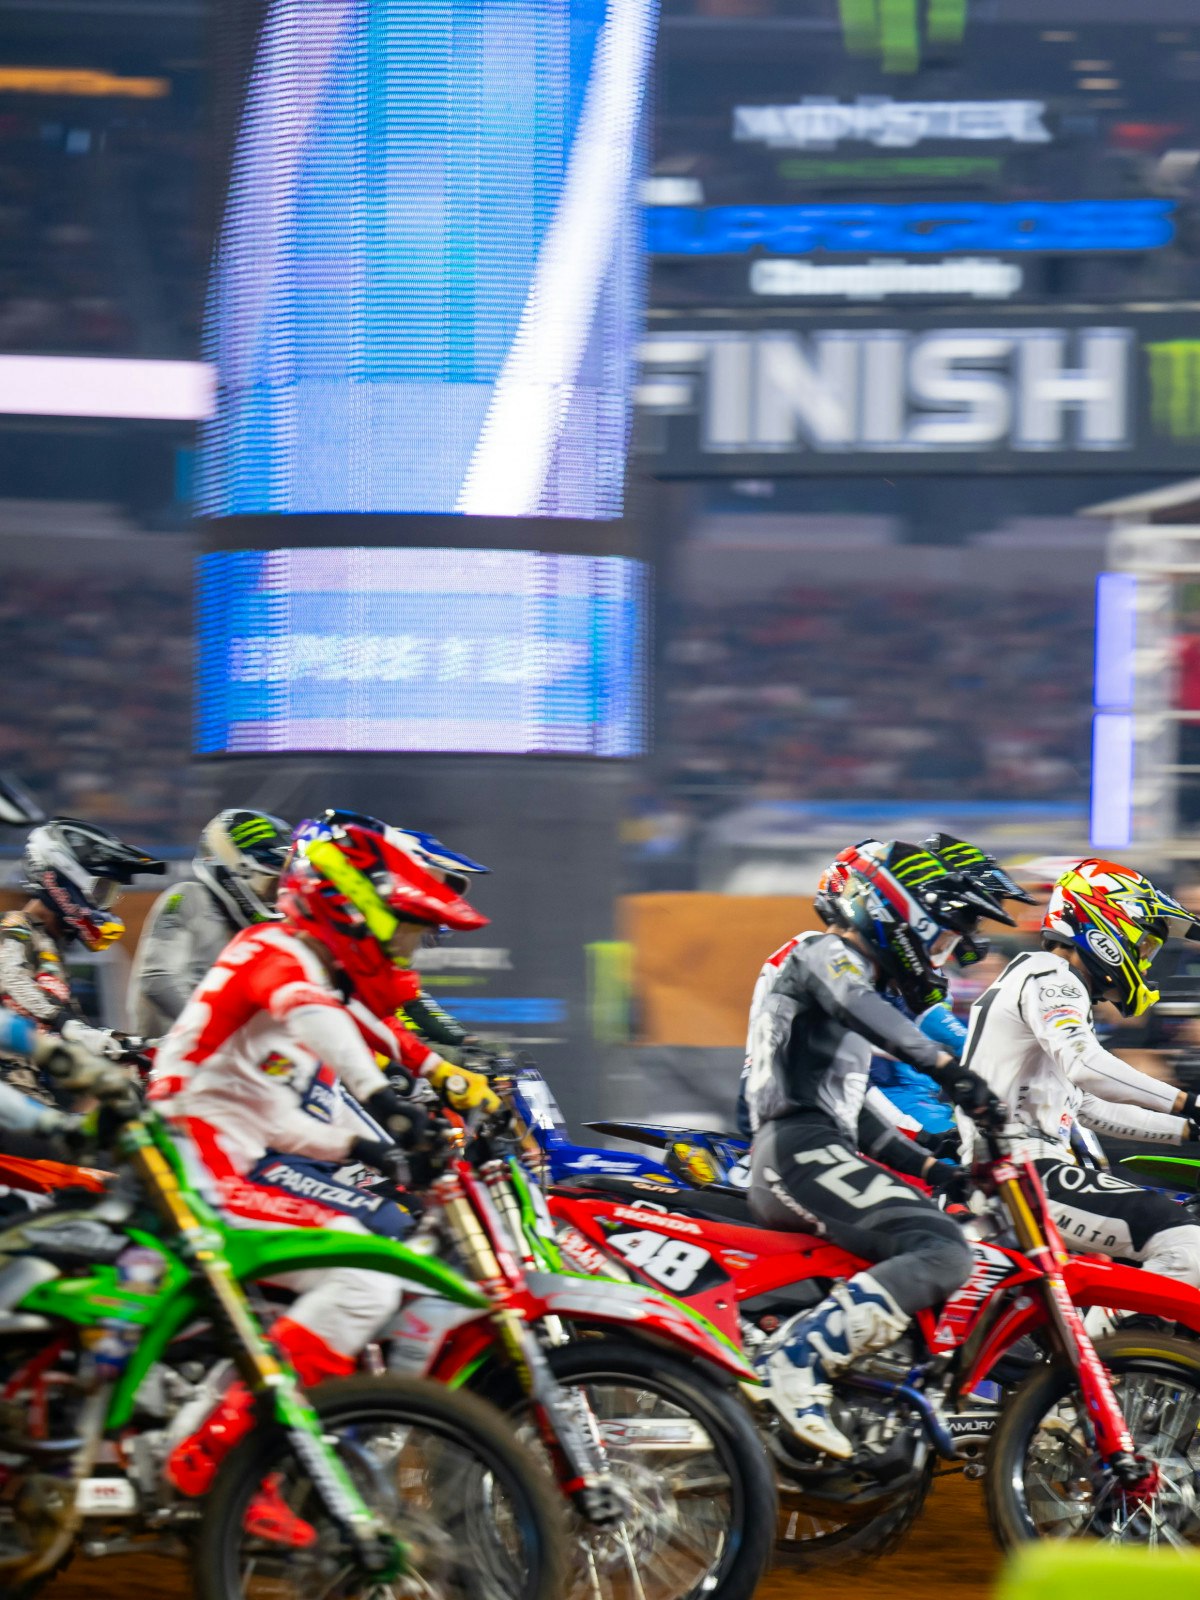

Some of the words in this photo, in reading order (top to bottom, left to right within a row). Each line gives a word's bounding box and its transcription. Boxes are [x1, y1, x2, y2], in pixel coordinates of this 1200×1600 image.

[635, 329, 1134, 453] FINISH
[1091, 932, 1121, 960] Arai
[613, 1207, 703, 1234] HONDA
[606, 1230, 711, 1292] 48
